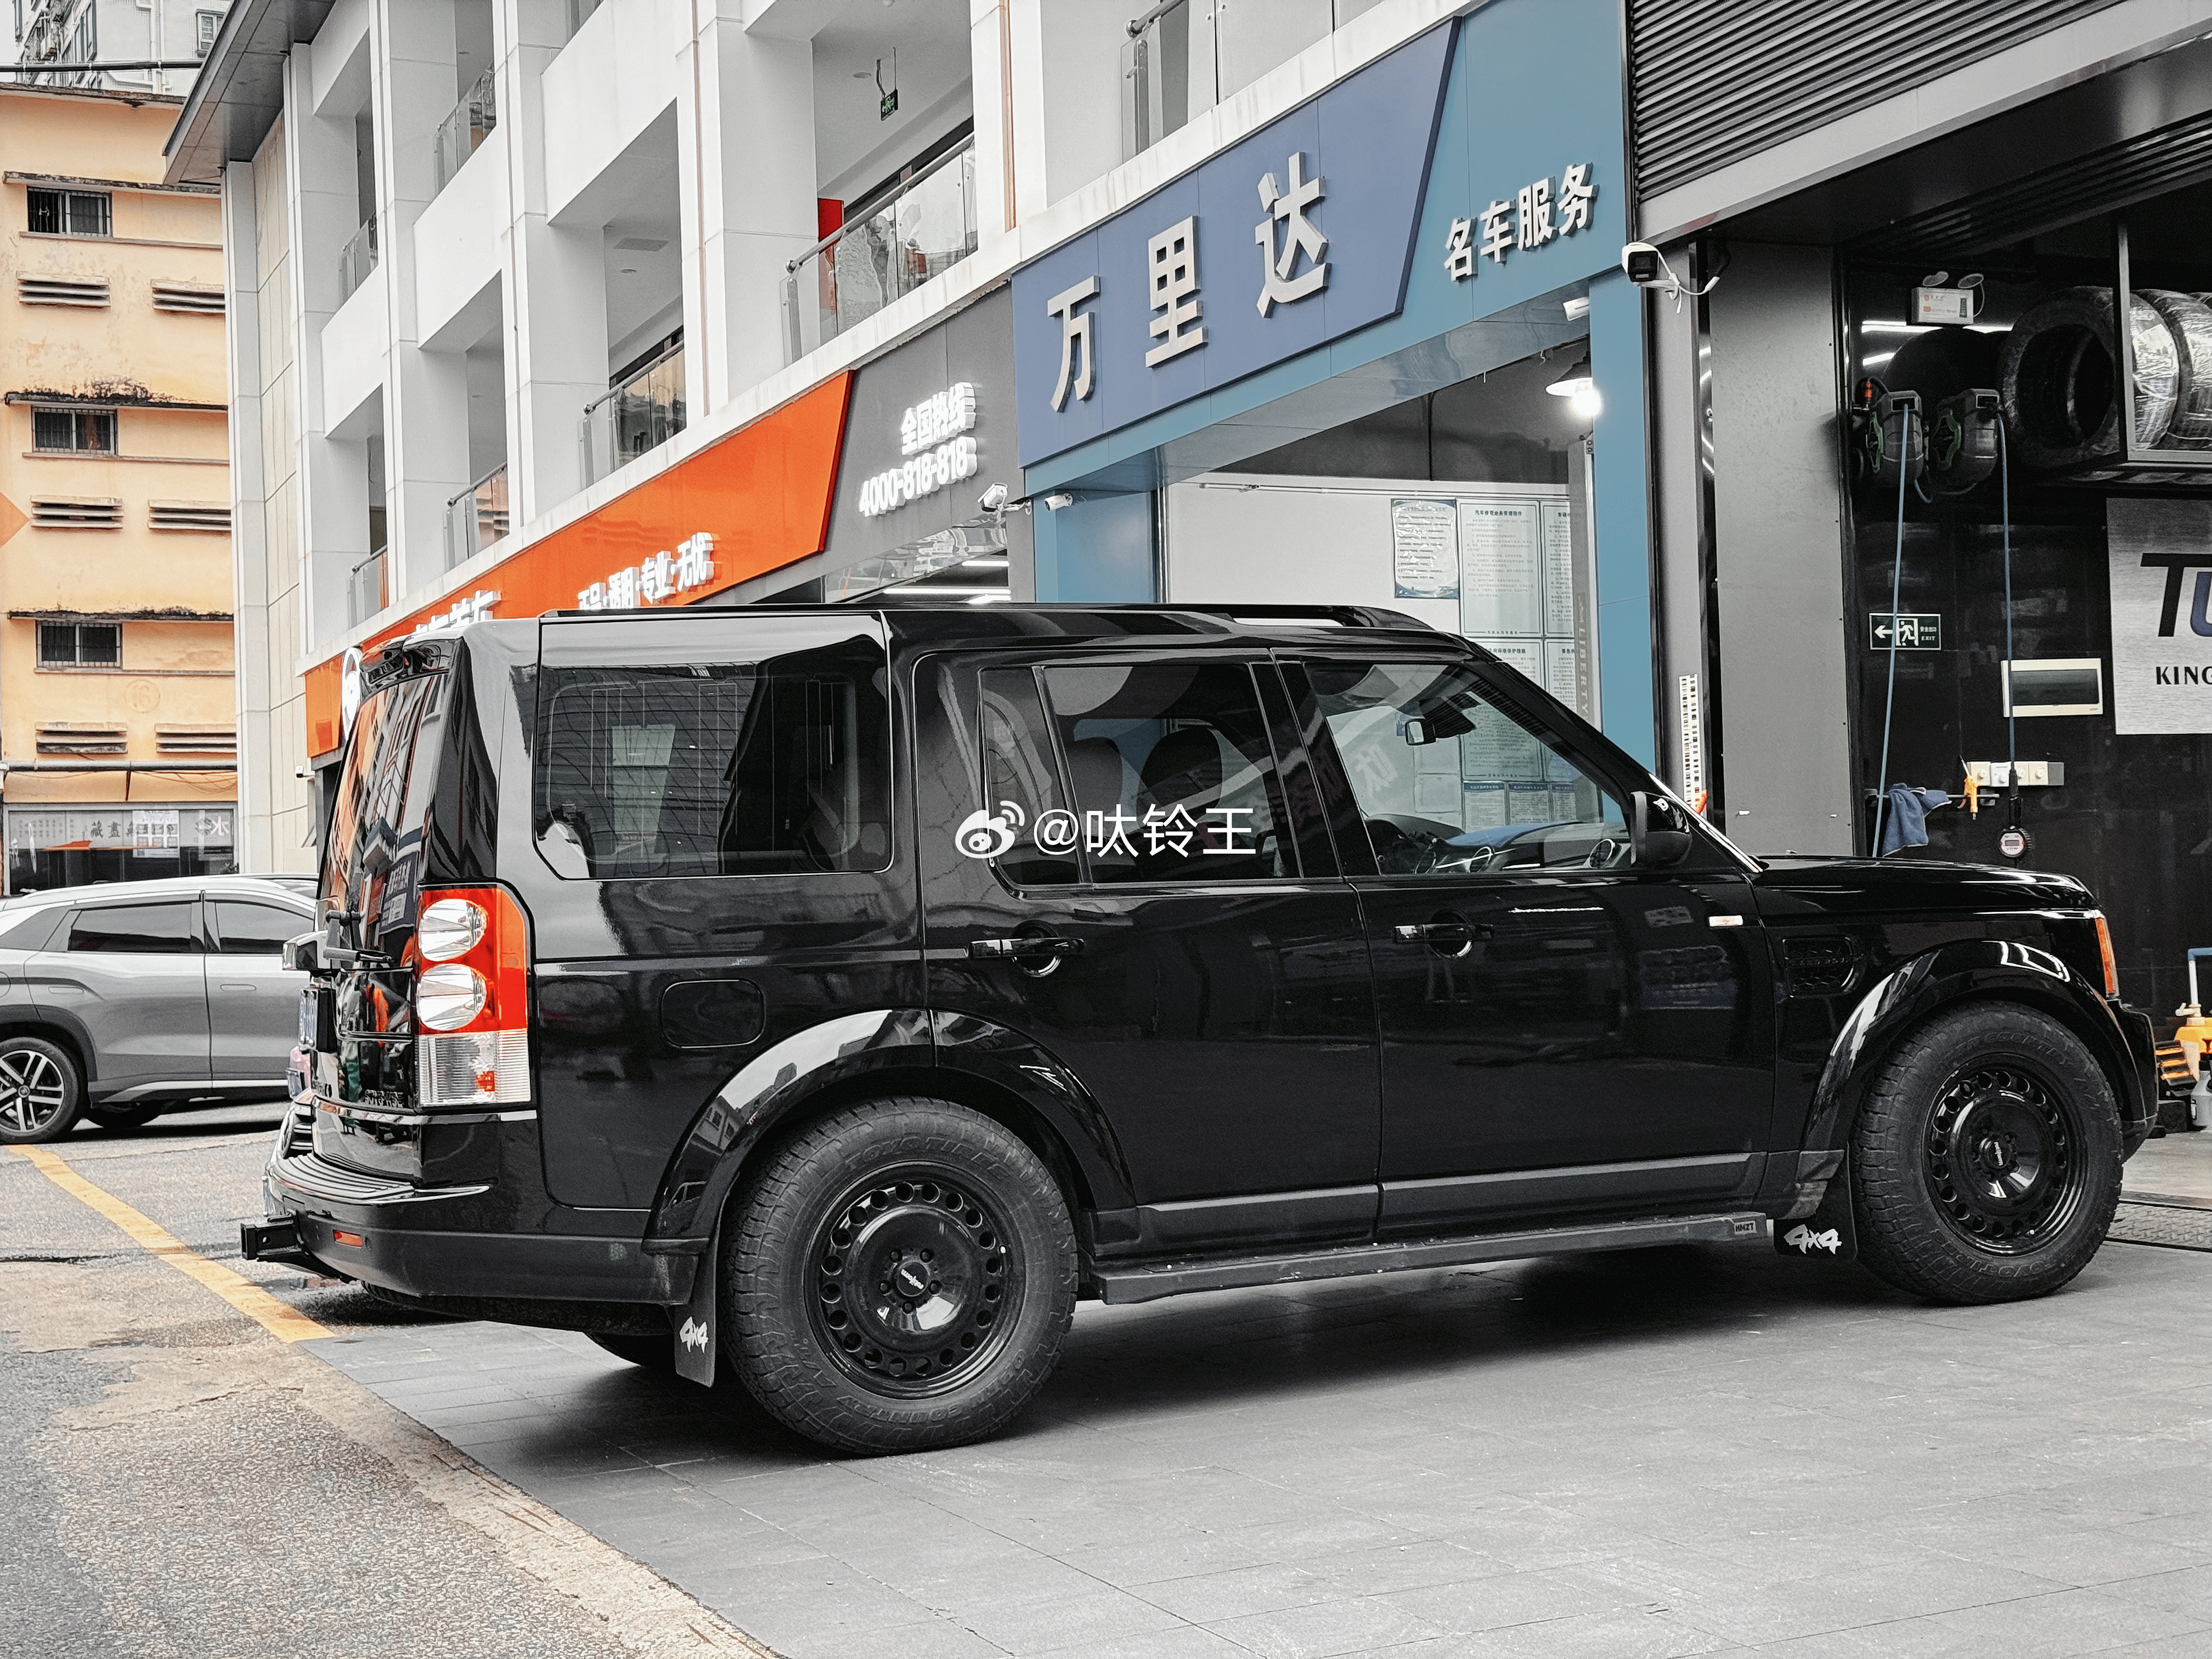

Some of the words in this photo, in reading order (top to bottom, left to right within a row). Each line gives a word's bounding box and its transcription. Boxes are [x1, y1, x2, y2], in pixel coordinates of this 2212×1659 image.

[1443, 163, 1599, 282] 名车服务
[1047, 151, 1330, 413] 万里达
[900, 382, 975, 455] 全国热线
[1578, 628, 1589, 715] LIBERTY
